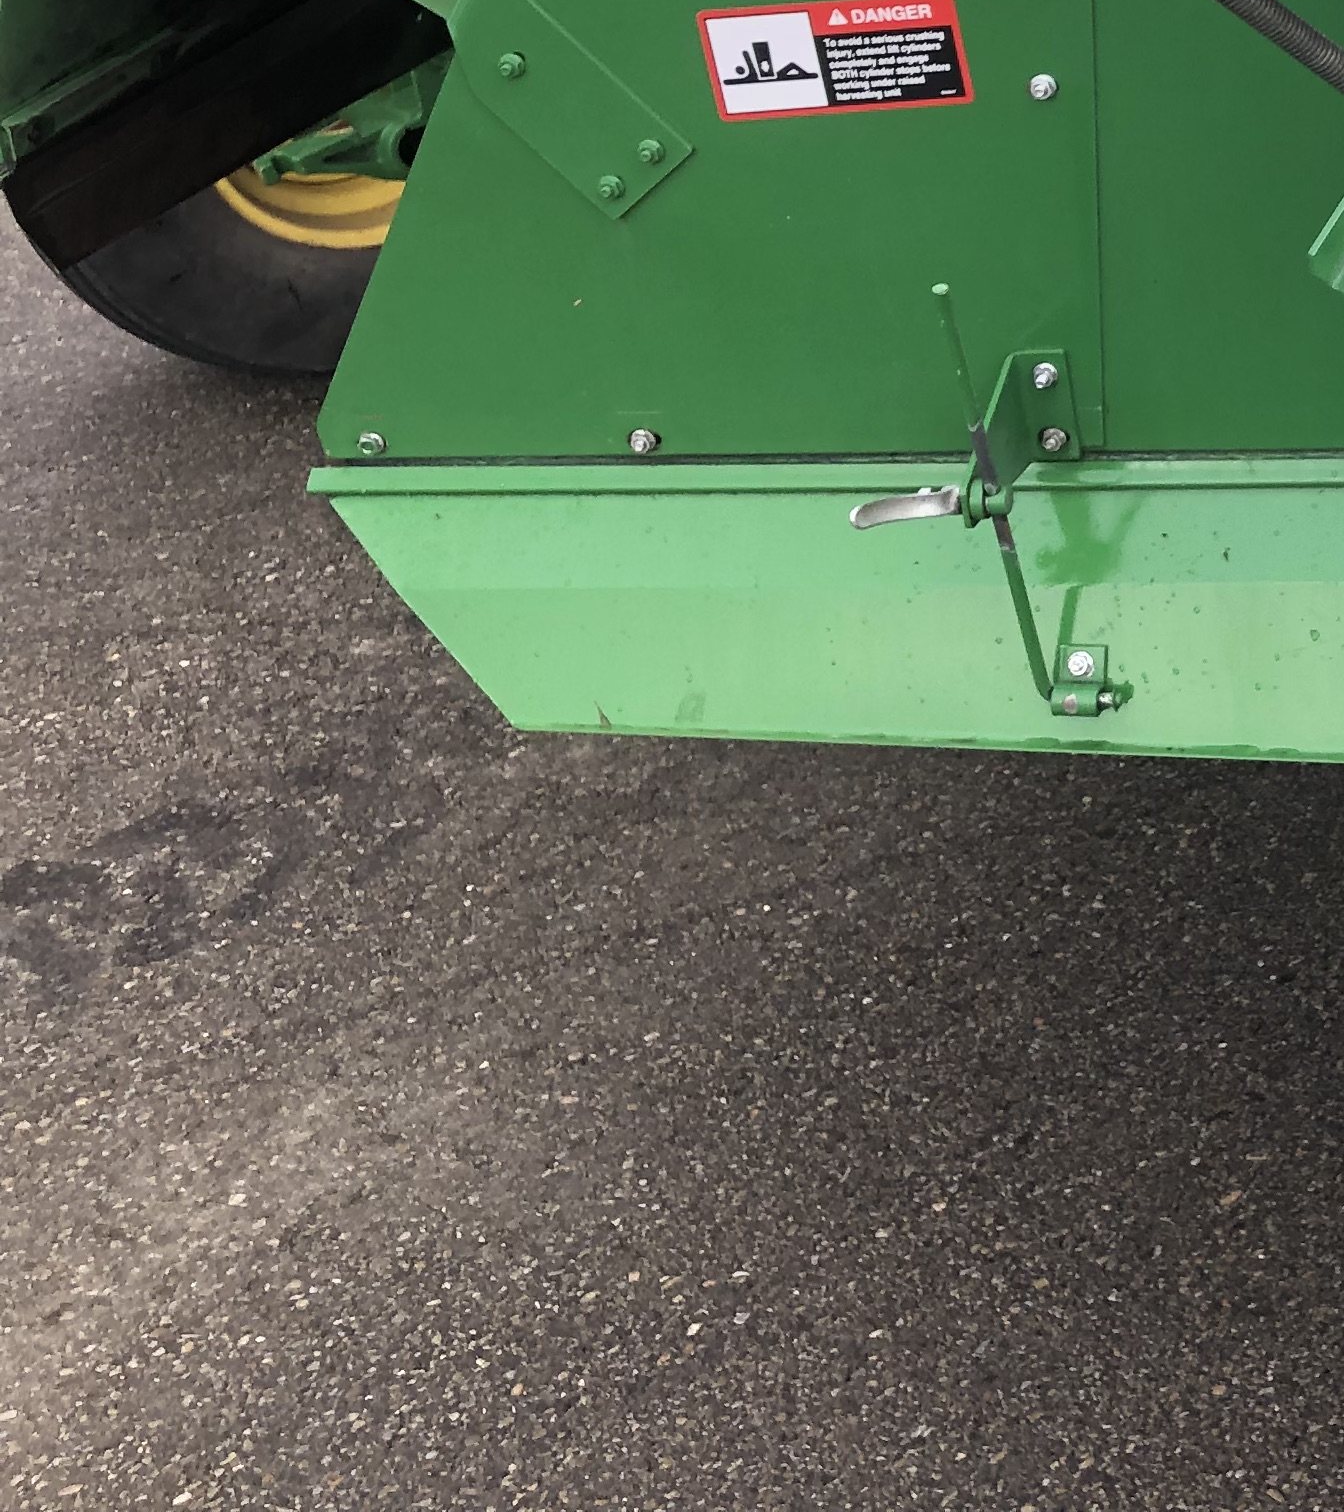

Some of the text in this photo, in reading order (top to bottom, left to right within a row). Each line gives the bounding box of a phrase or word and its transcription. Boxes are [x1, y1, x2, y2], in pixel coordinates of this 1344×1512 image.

[850, 4, 933, 25] DANGER
[823, 31, 945, 48] To avoid a serious crushing
[855, 45, 886, 56] extend
[900, 42, 942, 54] cylinders
[828, 54, 929, 69] completely and engage
[830, 63, 951, 80] BOTH cylinder stops before
[833, 75, 926, 91] working under raised
[835, 90, 883, 101] harvesting
